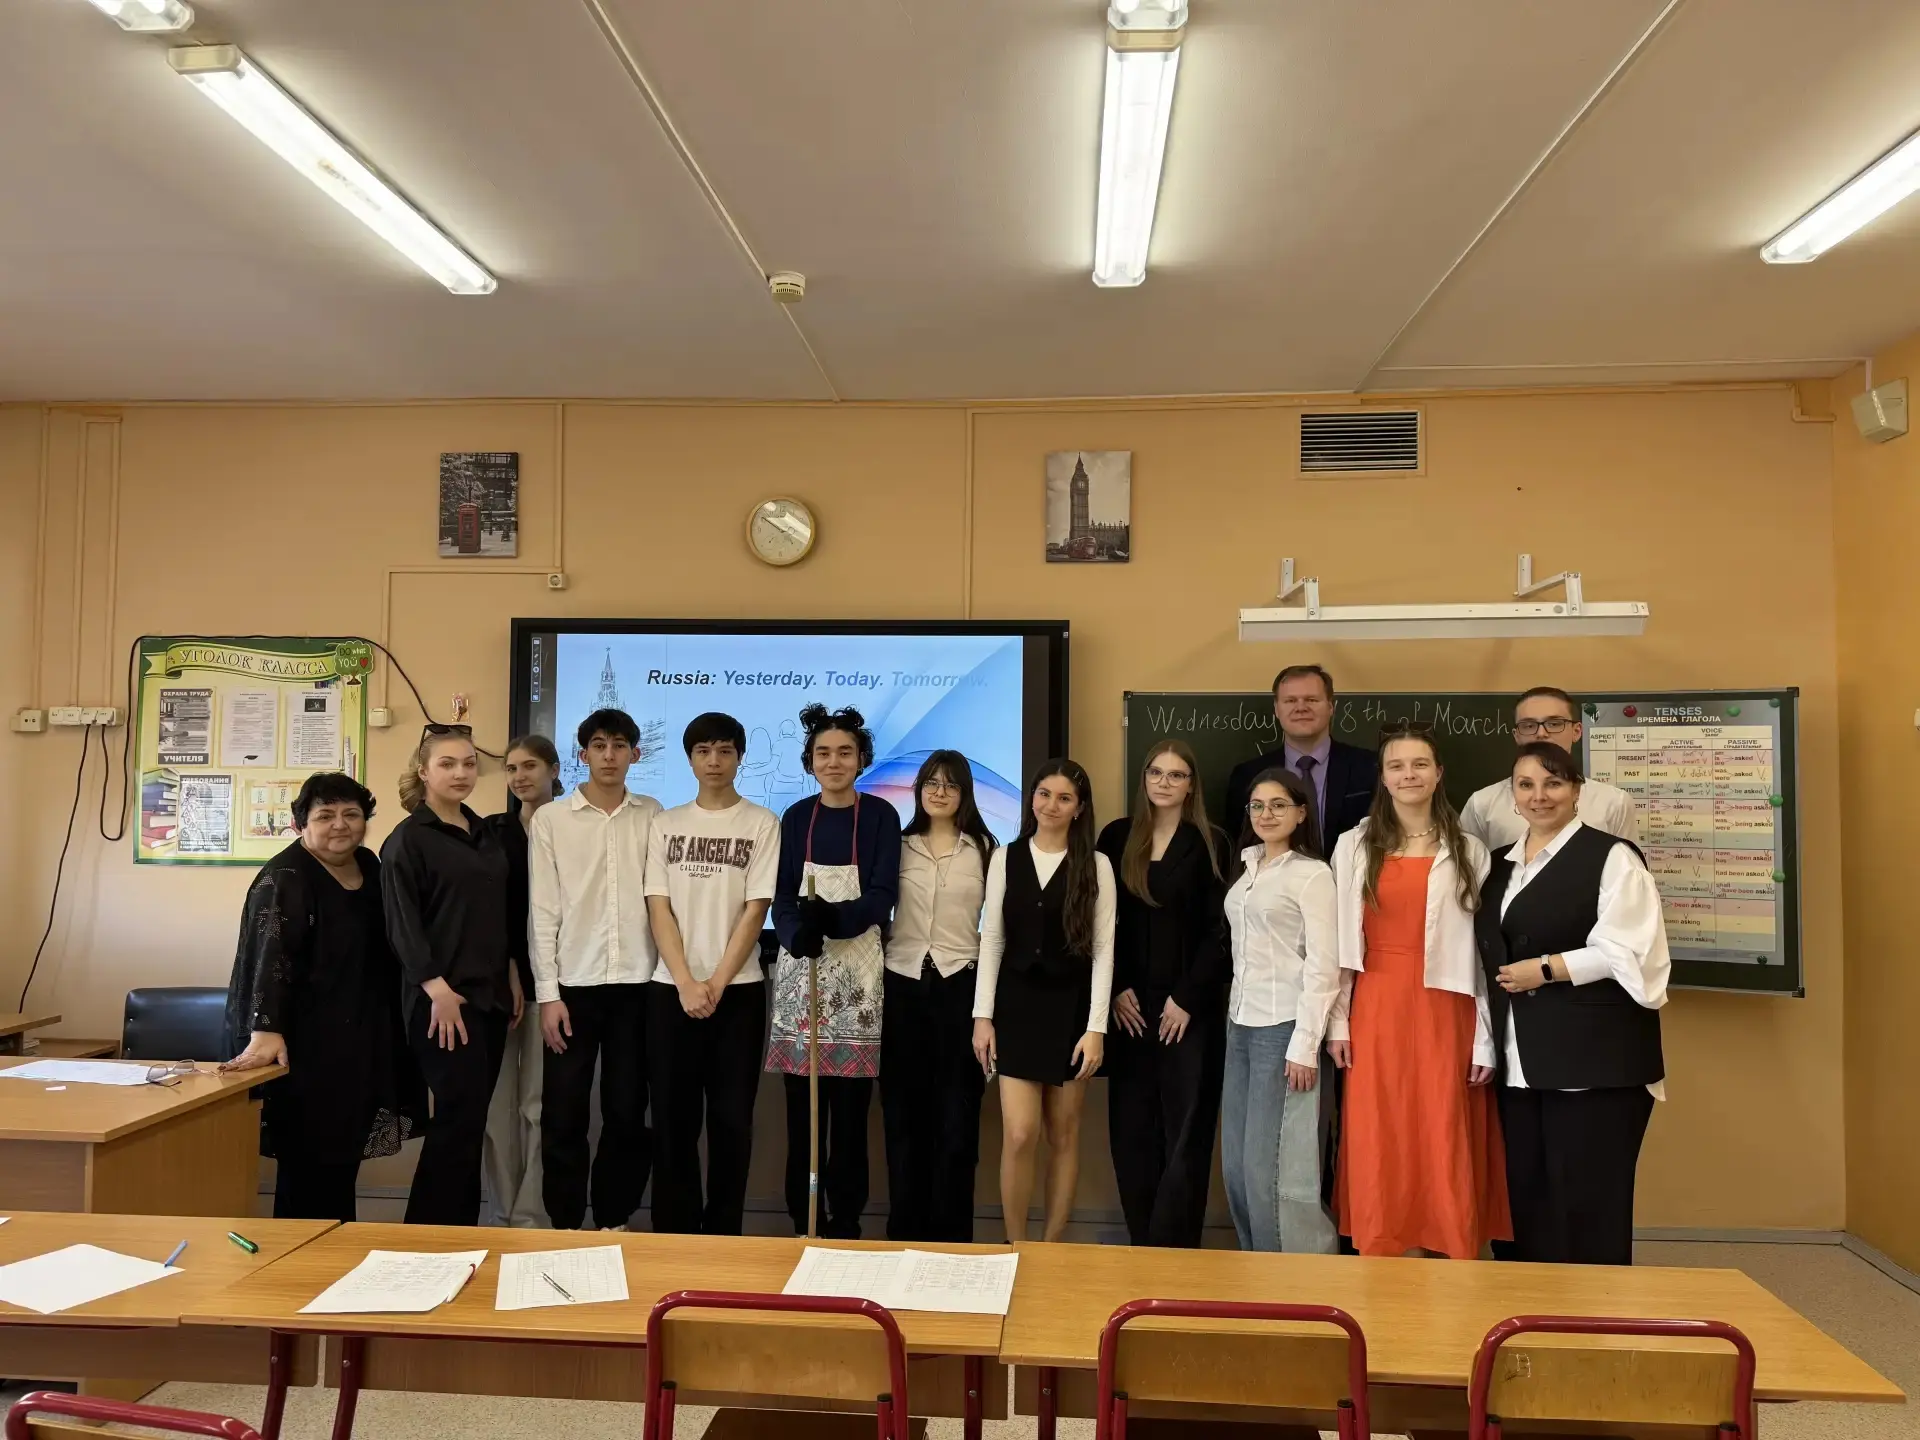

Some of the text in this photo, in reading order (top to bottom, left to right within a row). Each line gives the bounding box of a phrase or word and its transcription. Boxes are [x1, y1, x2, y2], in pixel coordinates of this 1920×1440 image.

[340, 647, 351, 656] DO
[180, 649, 330, 676] УГОЛОК КЛАССА
[646, 669, 989, 690] Russia: Yesterday. Today. Tomorrw.
[1654, 707, 1702, 716] TENSES
[664, 834, 754, 870] OS ANGELES
[680, 864, 722, 873] CALIFORNIA
